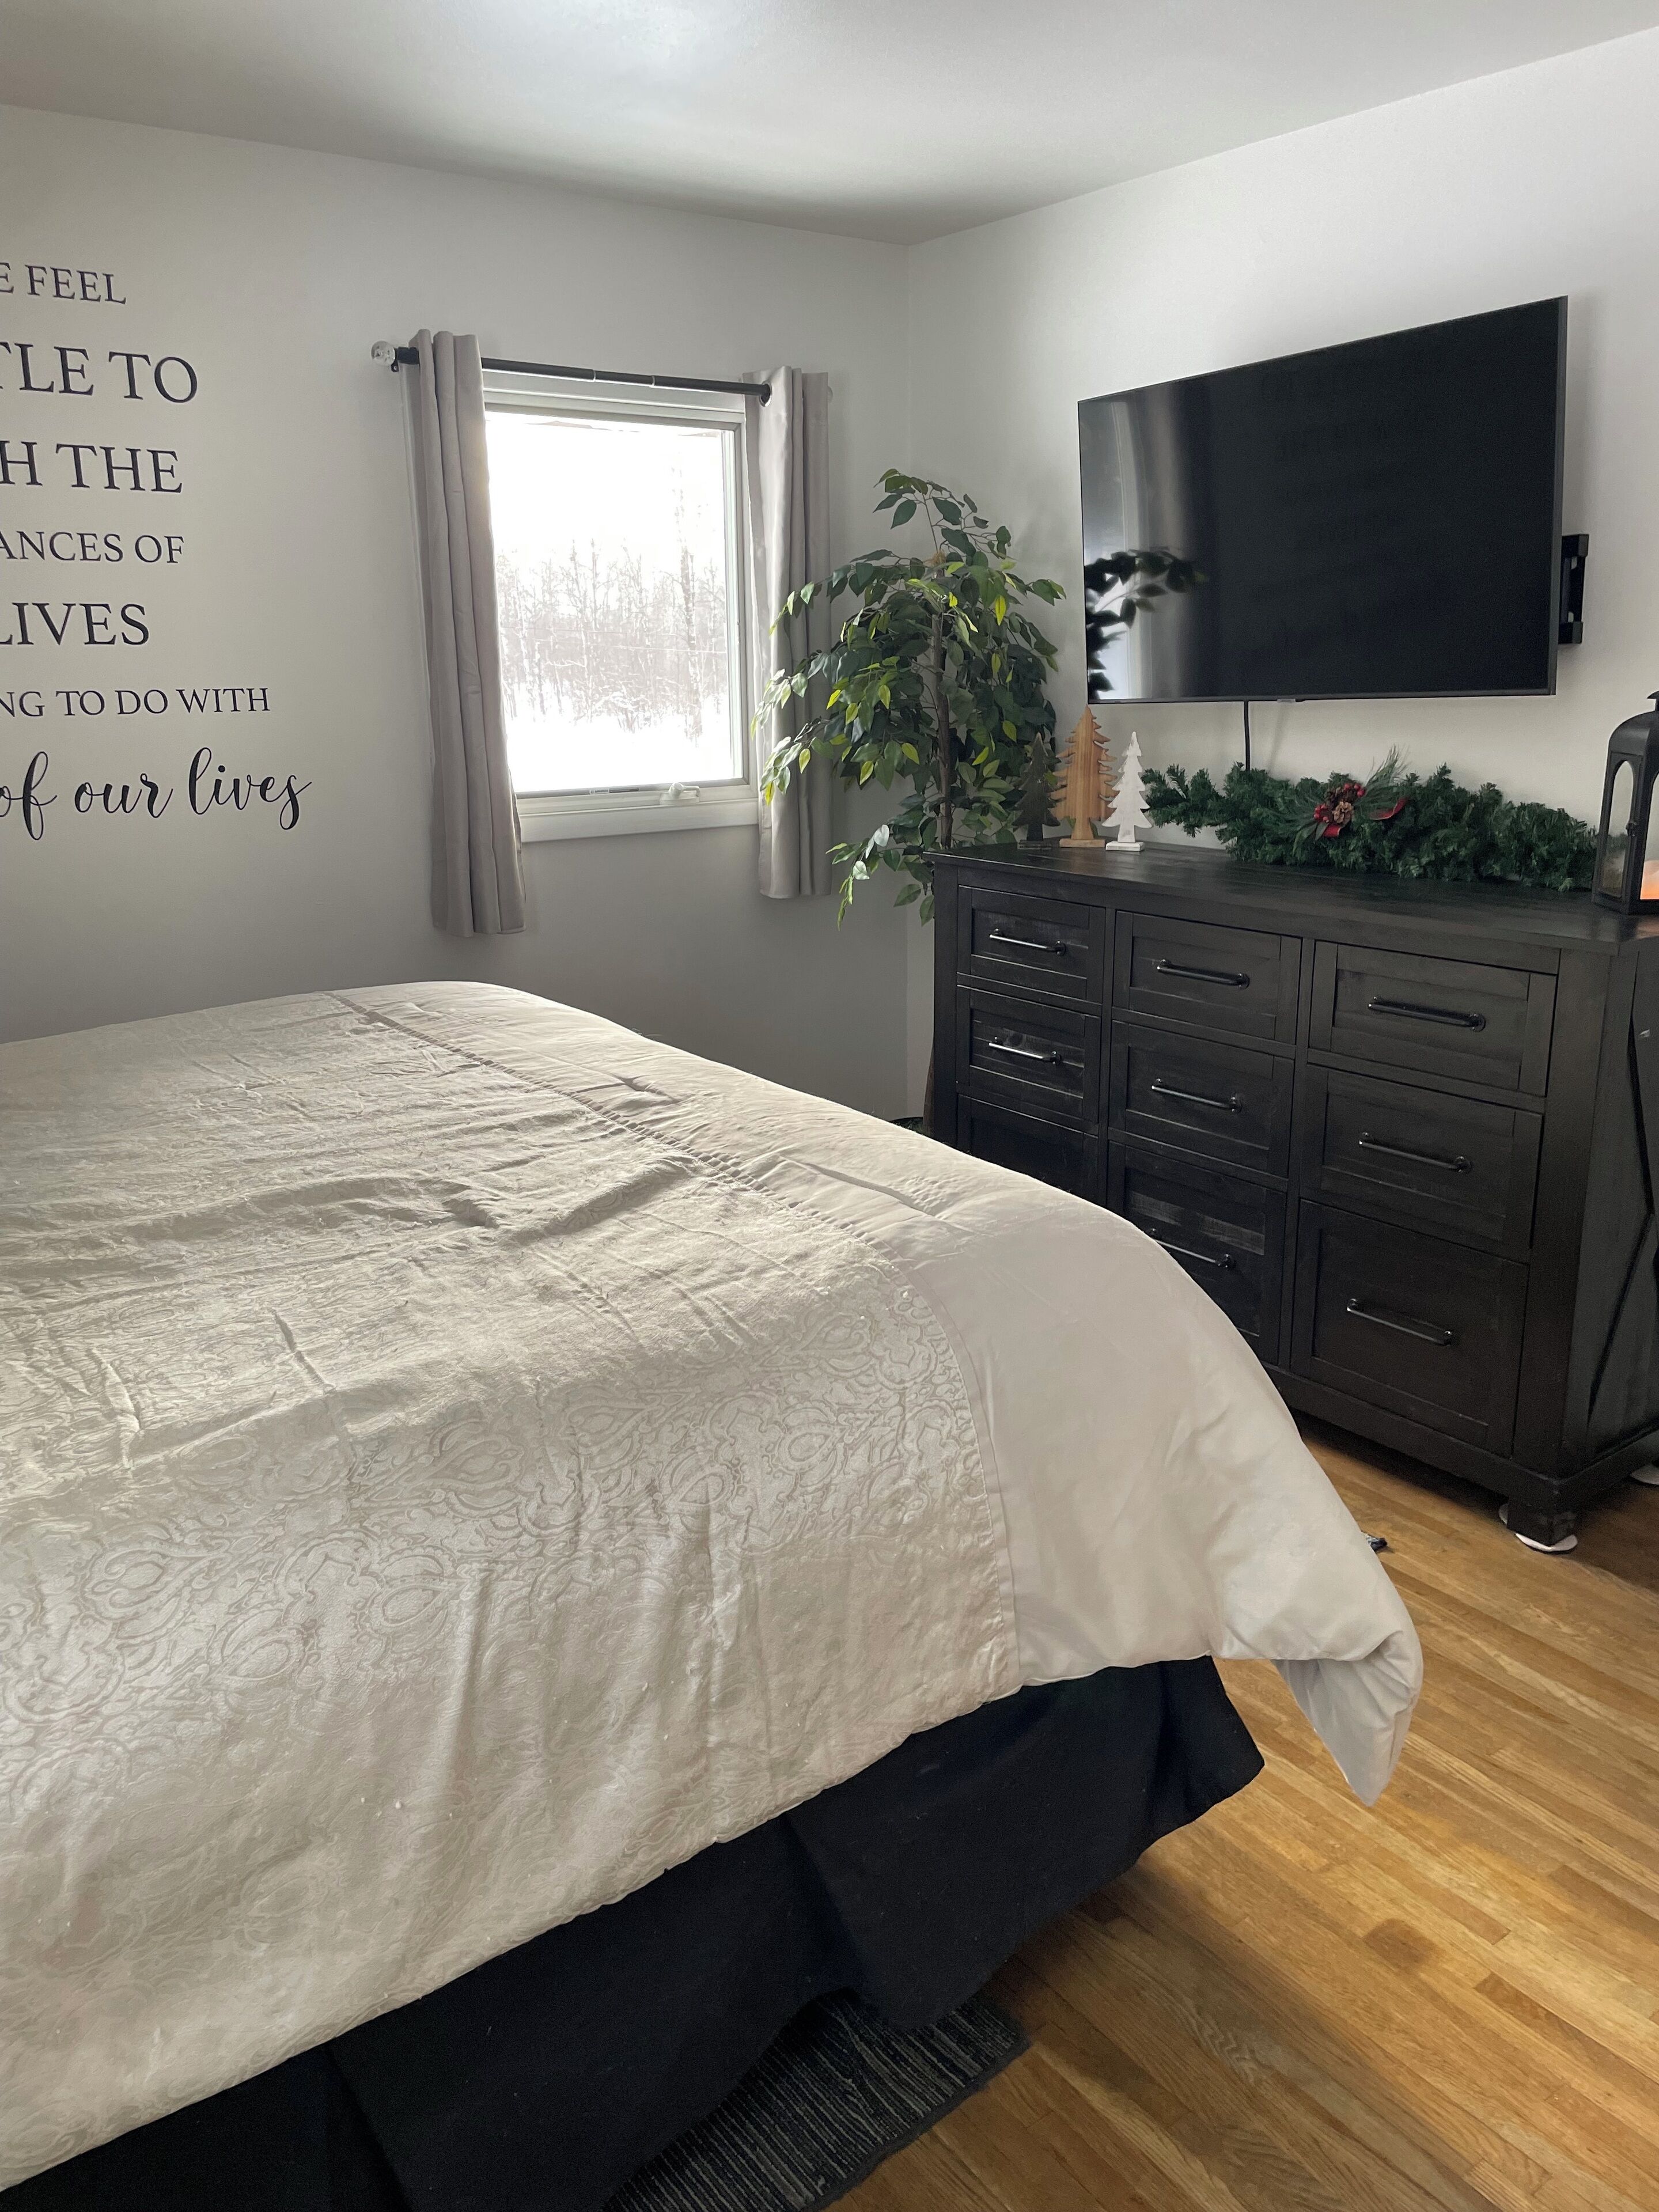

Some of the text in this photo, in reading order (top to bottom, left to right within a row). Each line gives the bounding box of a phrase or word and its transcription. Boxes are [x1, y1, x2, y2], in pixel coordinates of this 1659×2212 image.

[0, 262, 126, 305] E FEEL
[0, 342, 198, 403] LE TO
[0, 440, 183, 493] H THE
[0, 531, 184, 563] ANCES OF
[55, 690, 105, 716] TO
[114, 689, 168, 715] DO
[175, 687, 271, 713] WITH
[0, 747, 312, 841] of our lives
